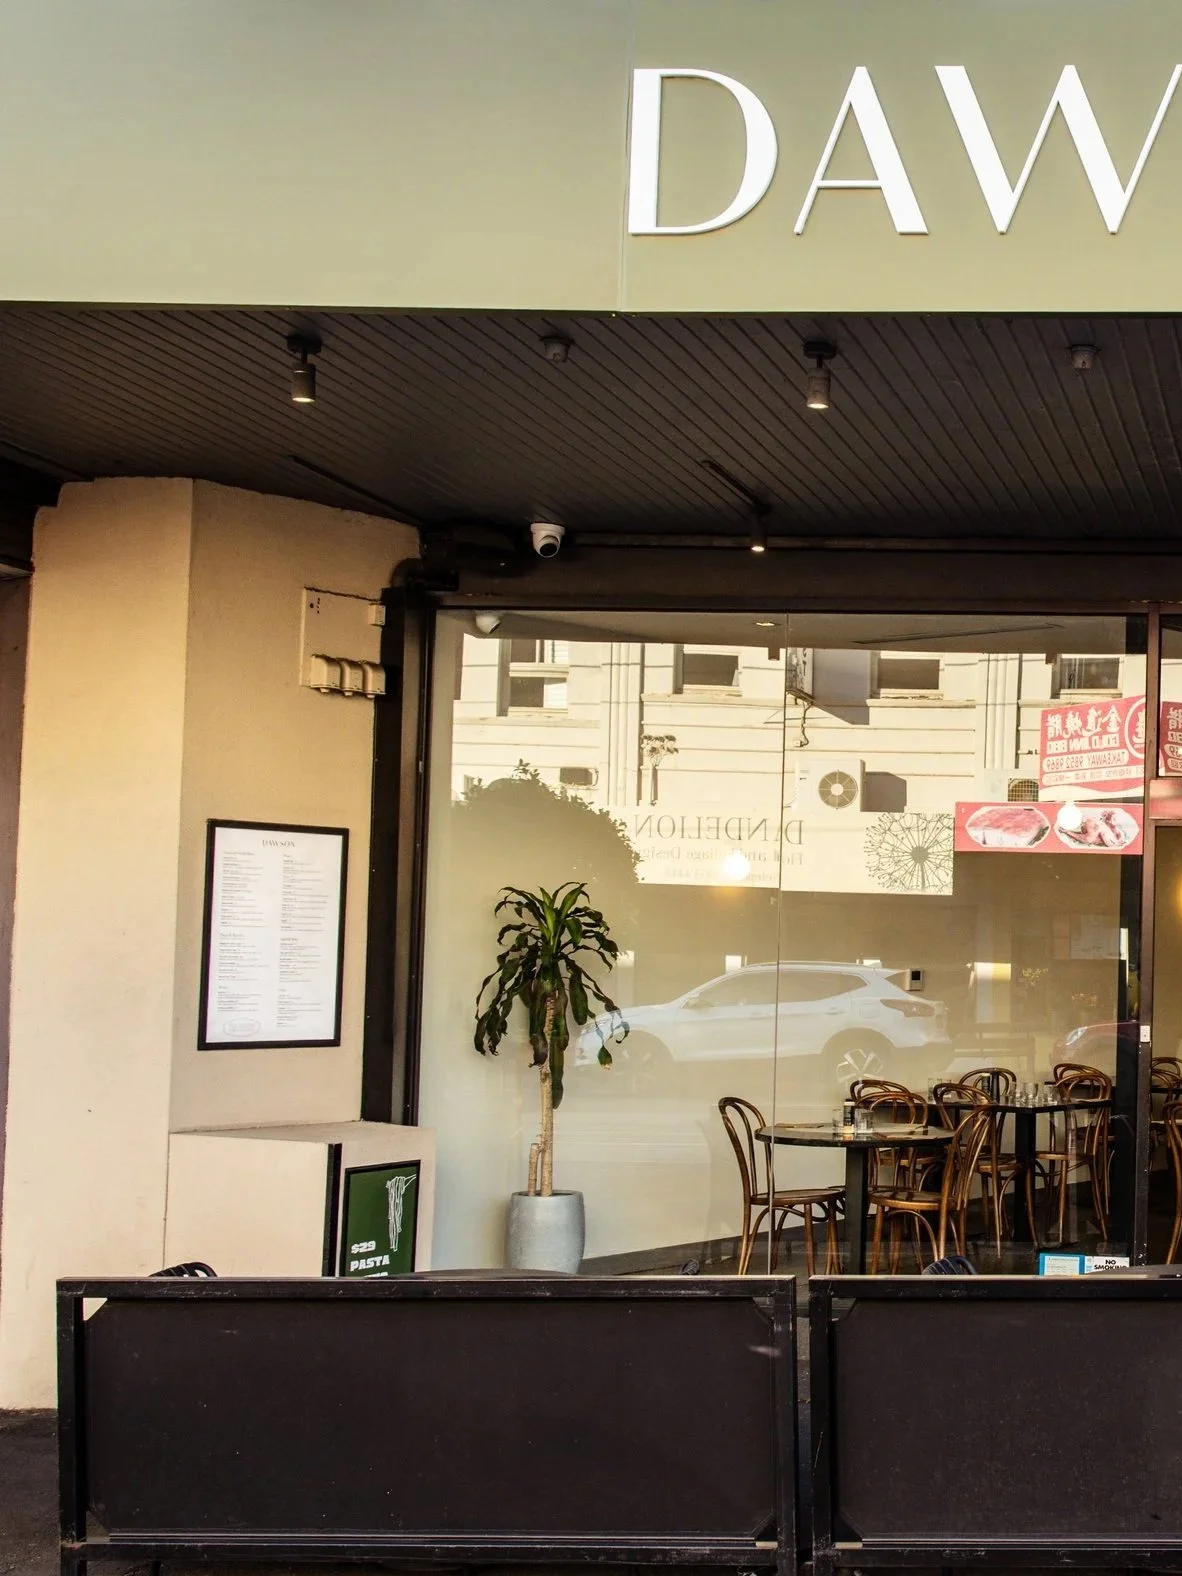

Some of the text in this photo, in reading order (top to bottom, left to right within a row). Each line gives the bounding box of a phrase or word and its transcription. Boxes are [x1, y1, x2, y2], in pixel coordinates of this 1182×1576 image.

[262, 839, 295, 848] DAWSON
[350, 1240, 376, 1254] $29
[350, 1254, 390, 1272] PASTA
